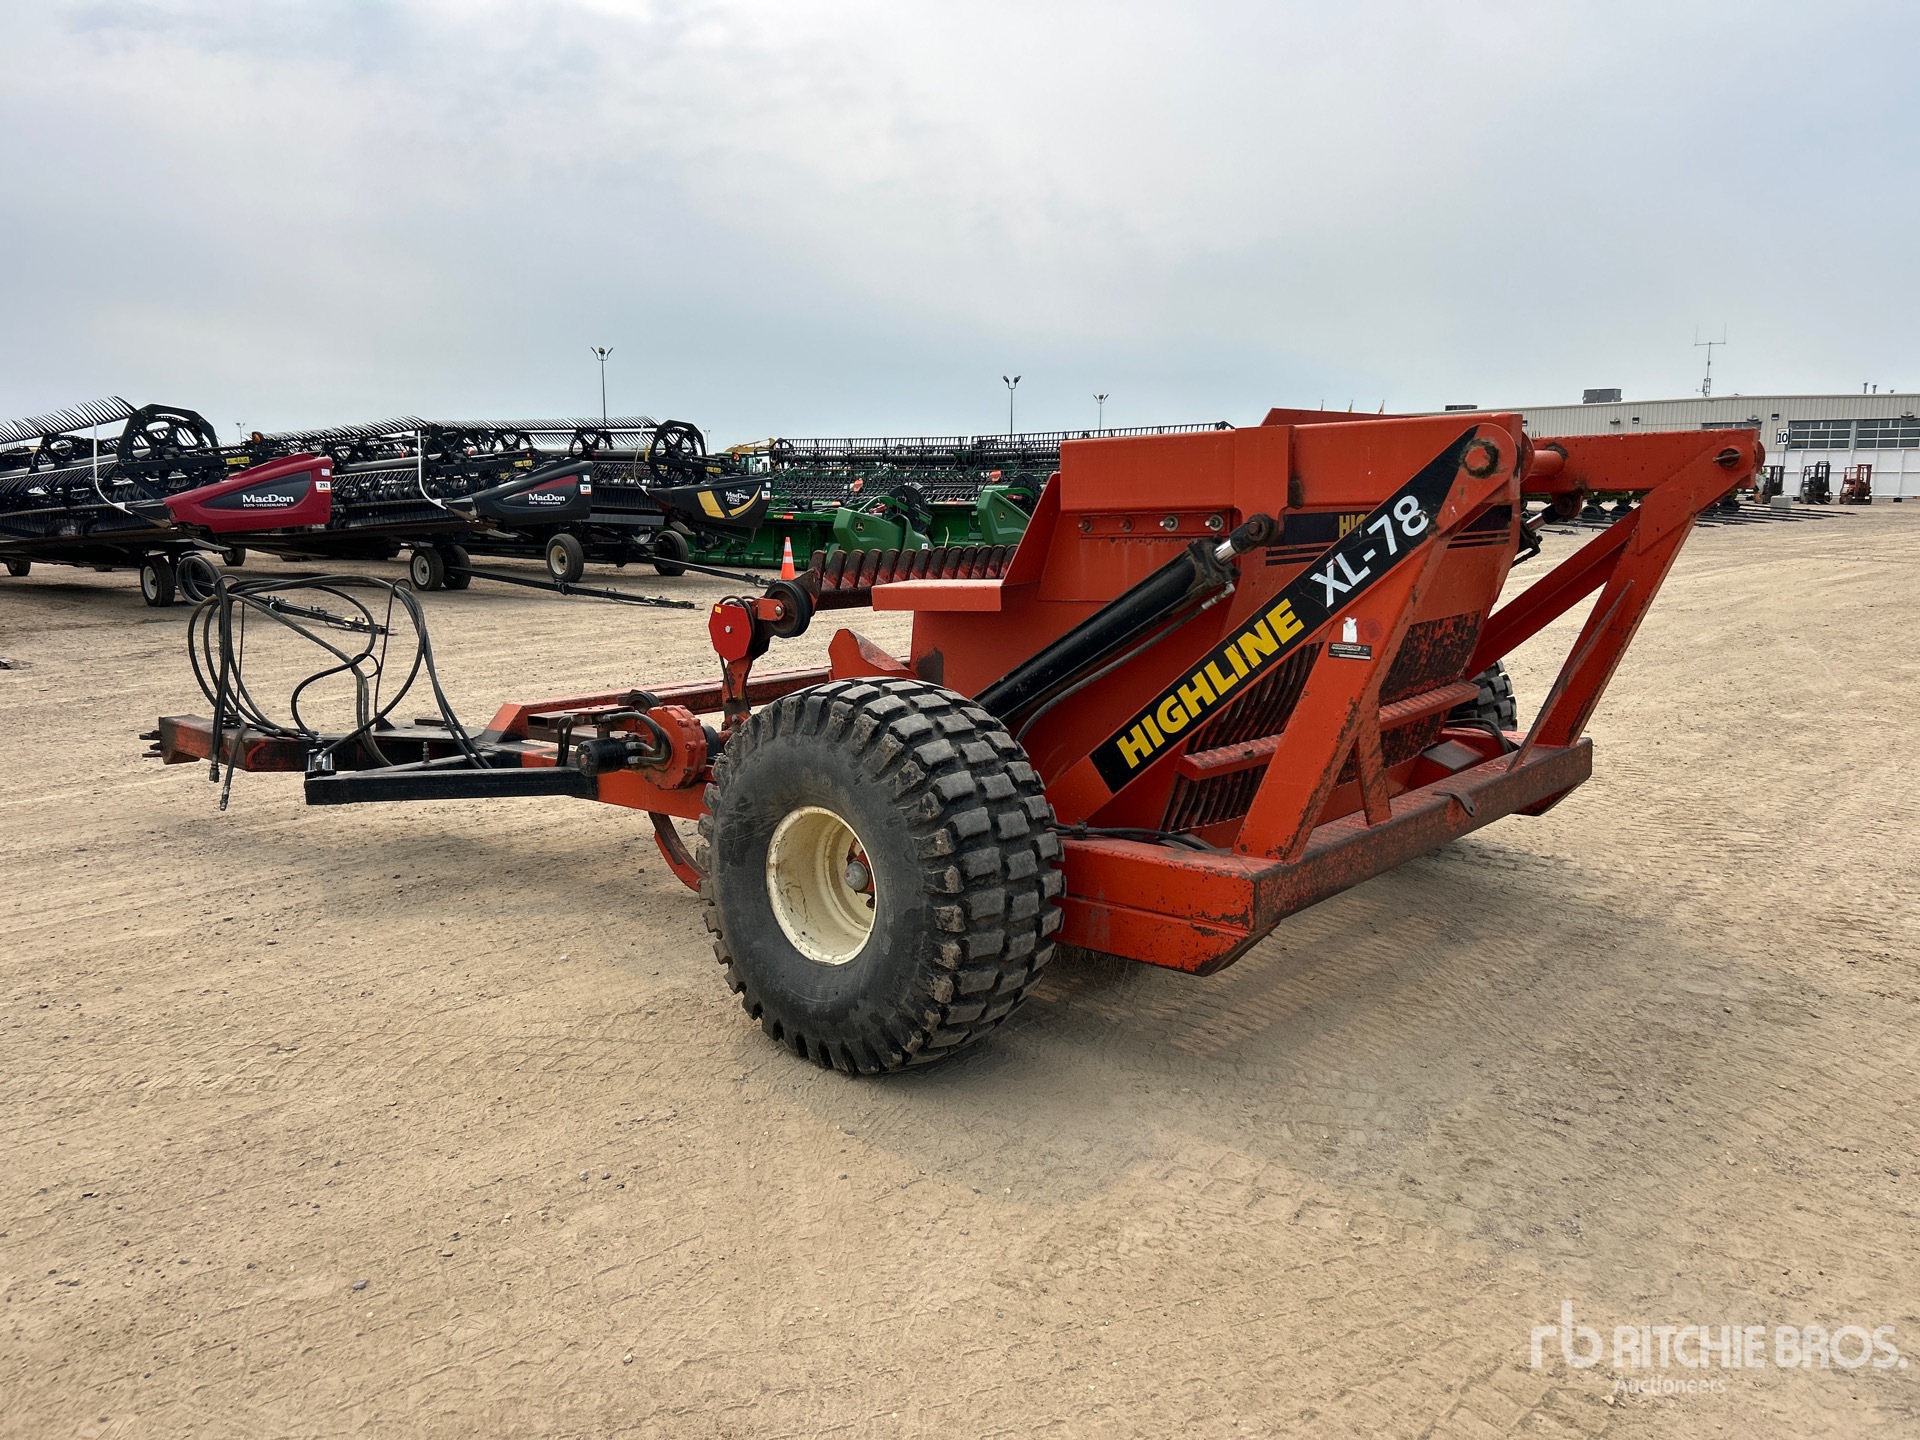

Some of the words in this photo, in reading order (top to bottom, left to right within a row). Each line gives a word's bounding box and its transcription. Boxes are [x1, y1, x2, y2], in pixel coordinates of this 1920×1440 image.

[1777, 433, 1788, 443] 10
[242, 494, 294, 503] MacDon
[528, 493, 566, 502] MacDon
[725, 491, 750, 500] MacDon
[1116, 598, 1305, 769] HIGHLINE
[1310, 495, 1430, 608] XL-78
